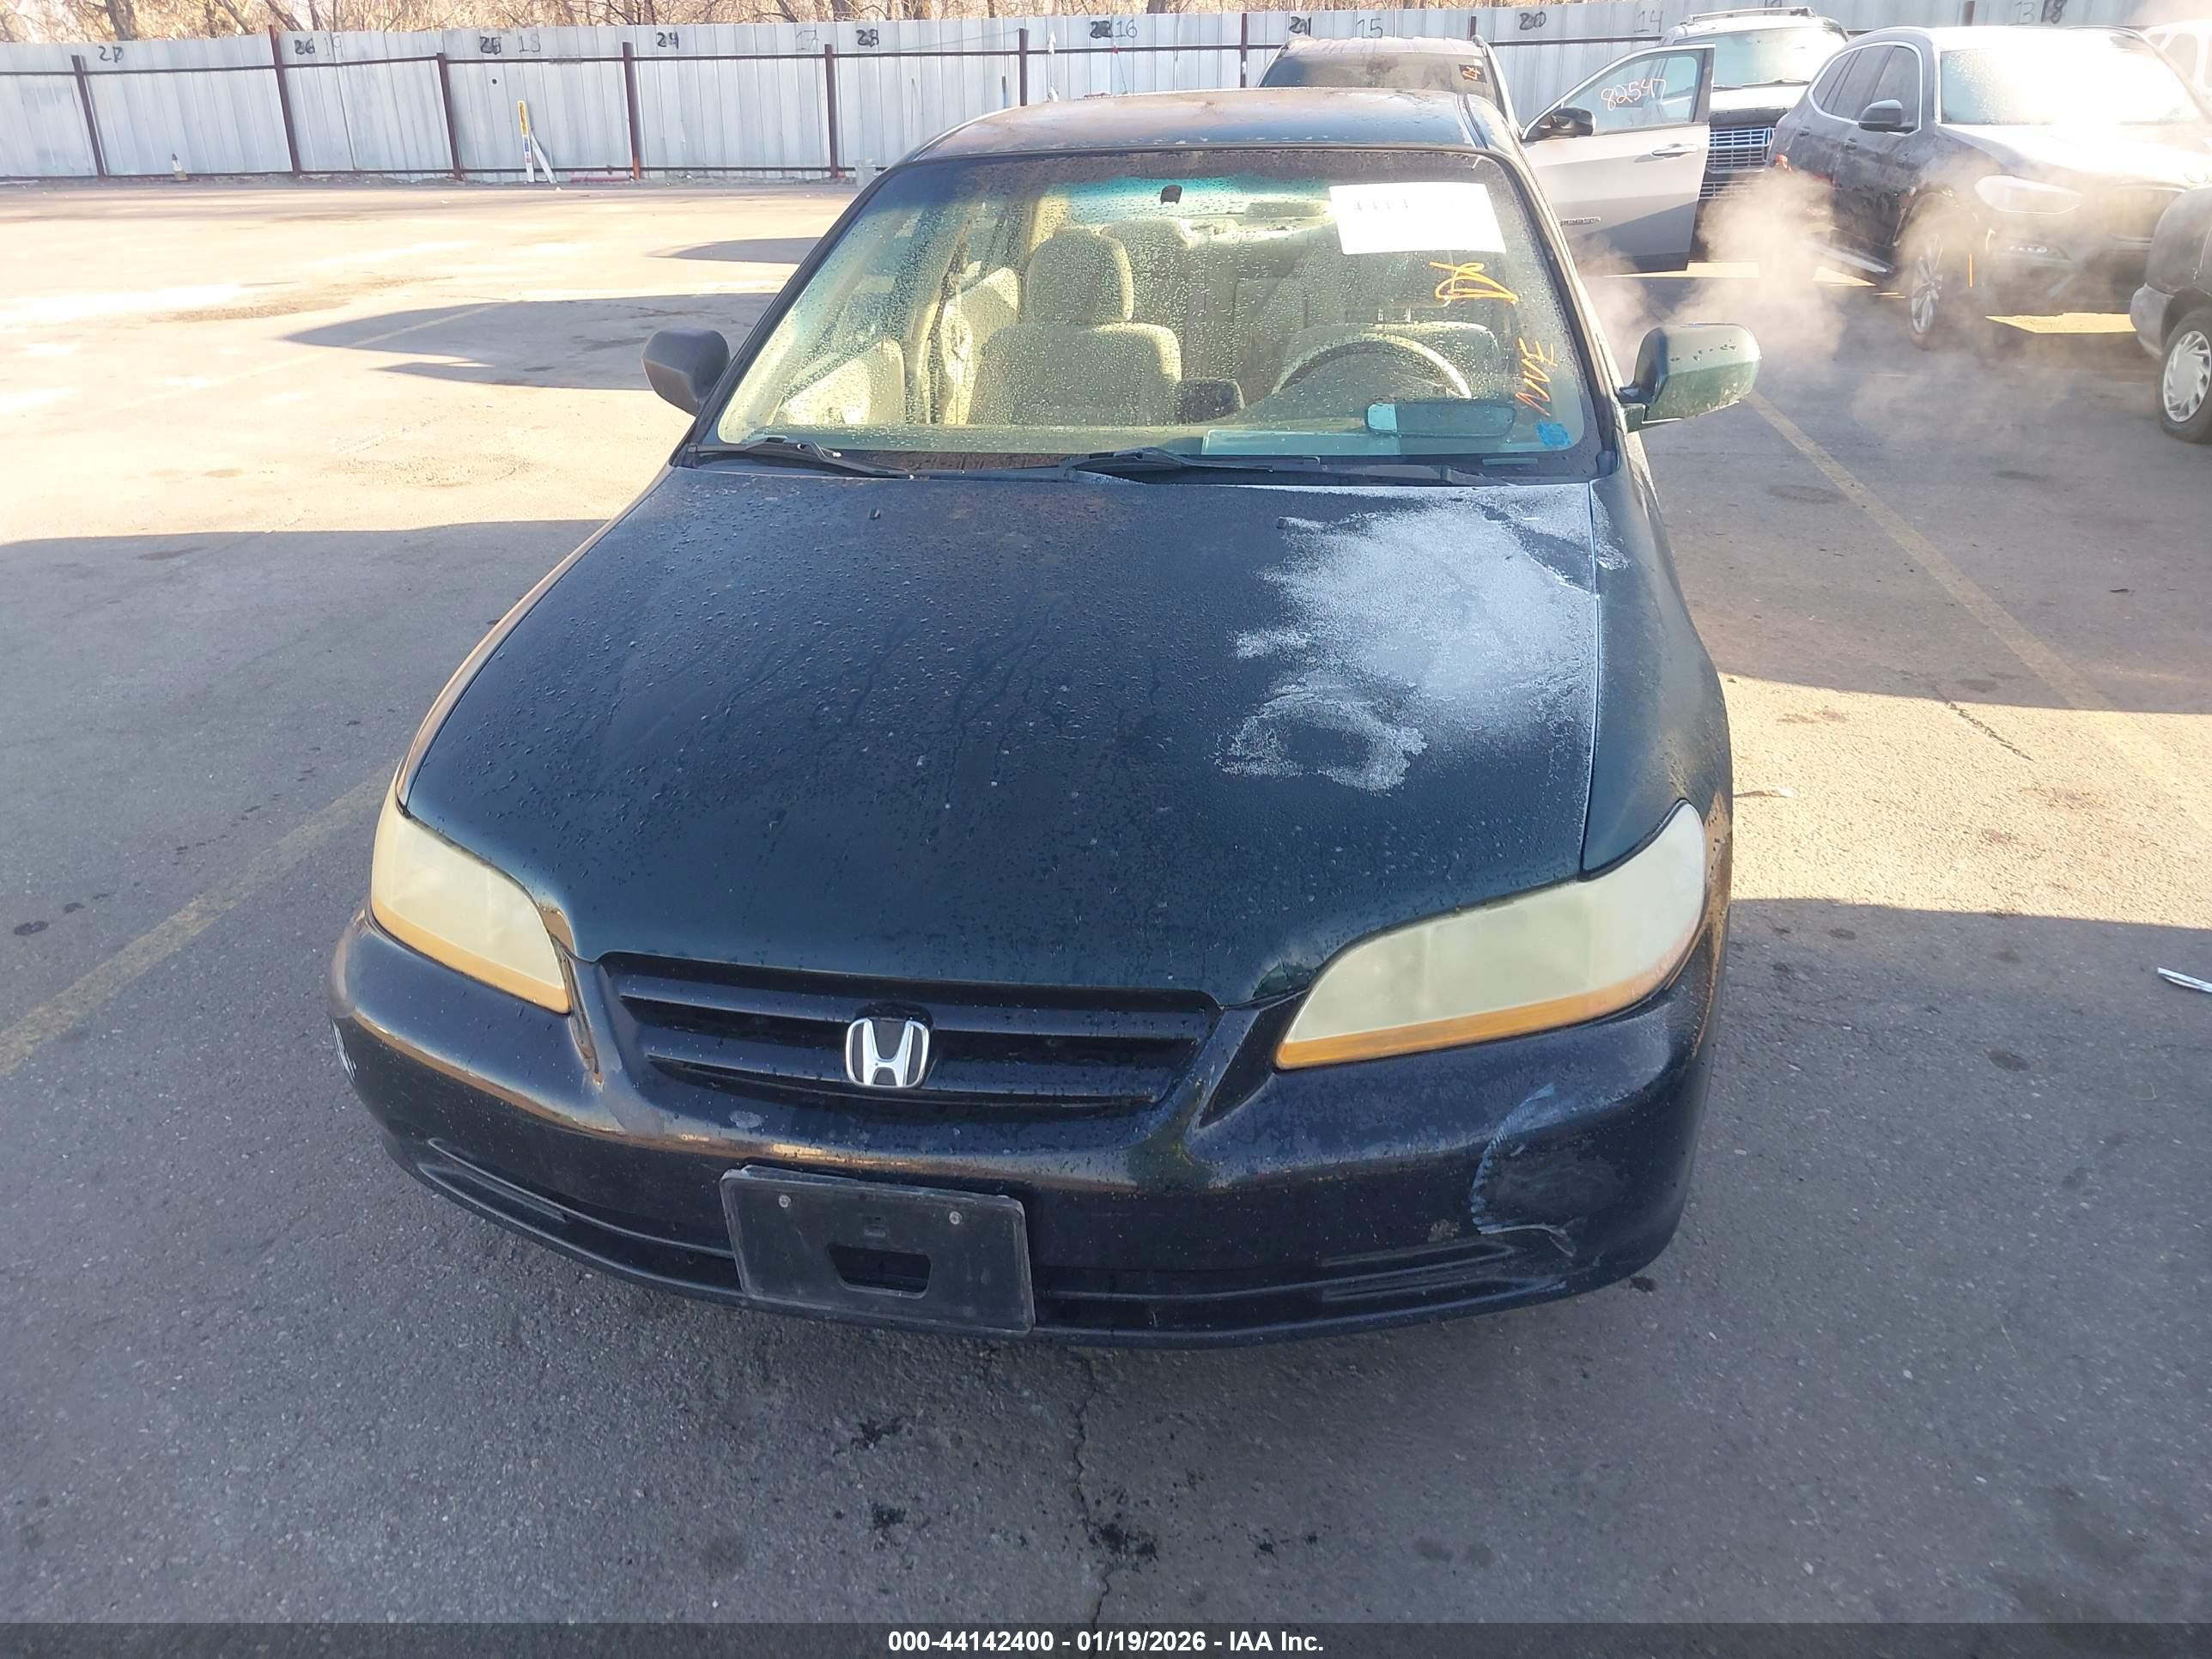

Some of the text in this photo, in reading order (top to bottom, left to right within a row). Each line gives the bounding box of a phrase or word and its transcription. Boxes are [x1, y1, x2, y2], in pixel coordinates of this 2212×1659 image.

[1113, 18, 1138, 38] 16
[1357, 18, 1383, 38] 15
[1634, 9, 1663, 33] 14
[656, 32, 679, 49] 24
[1601, 77, 1667, 112] 82547
